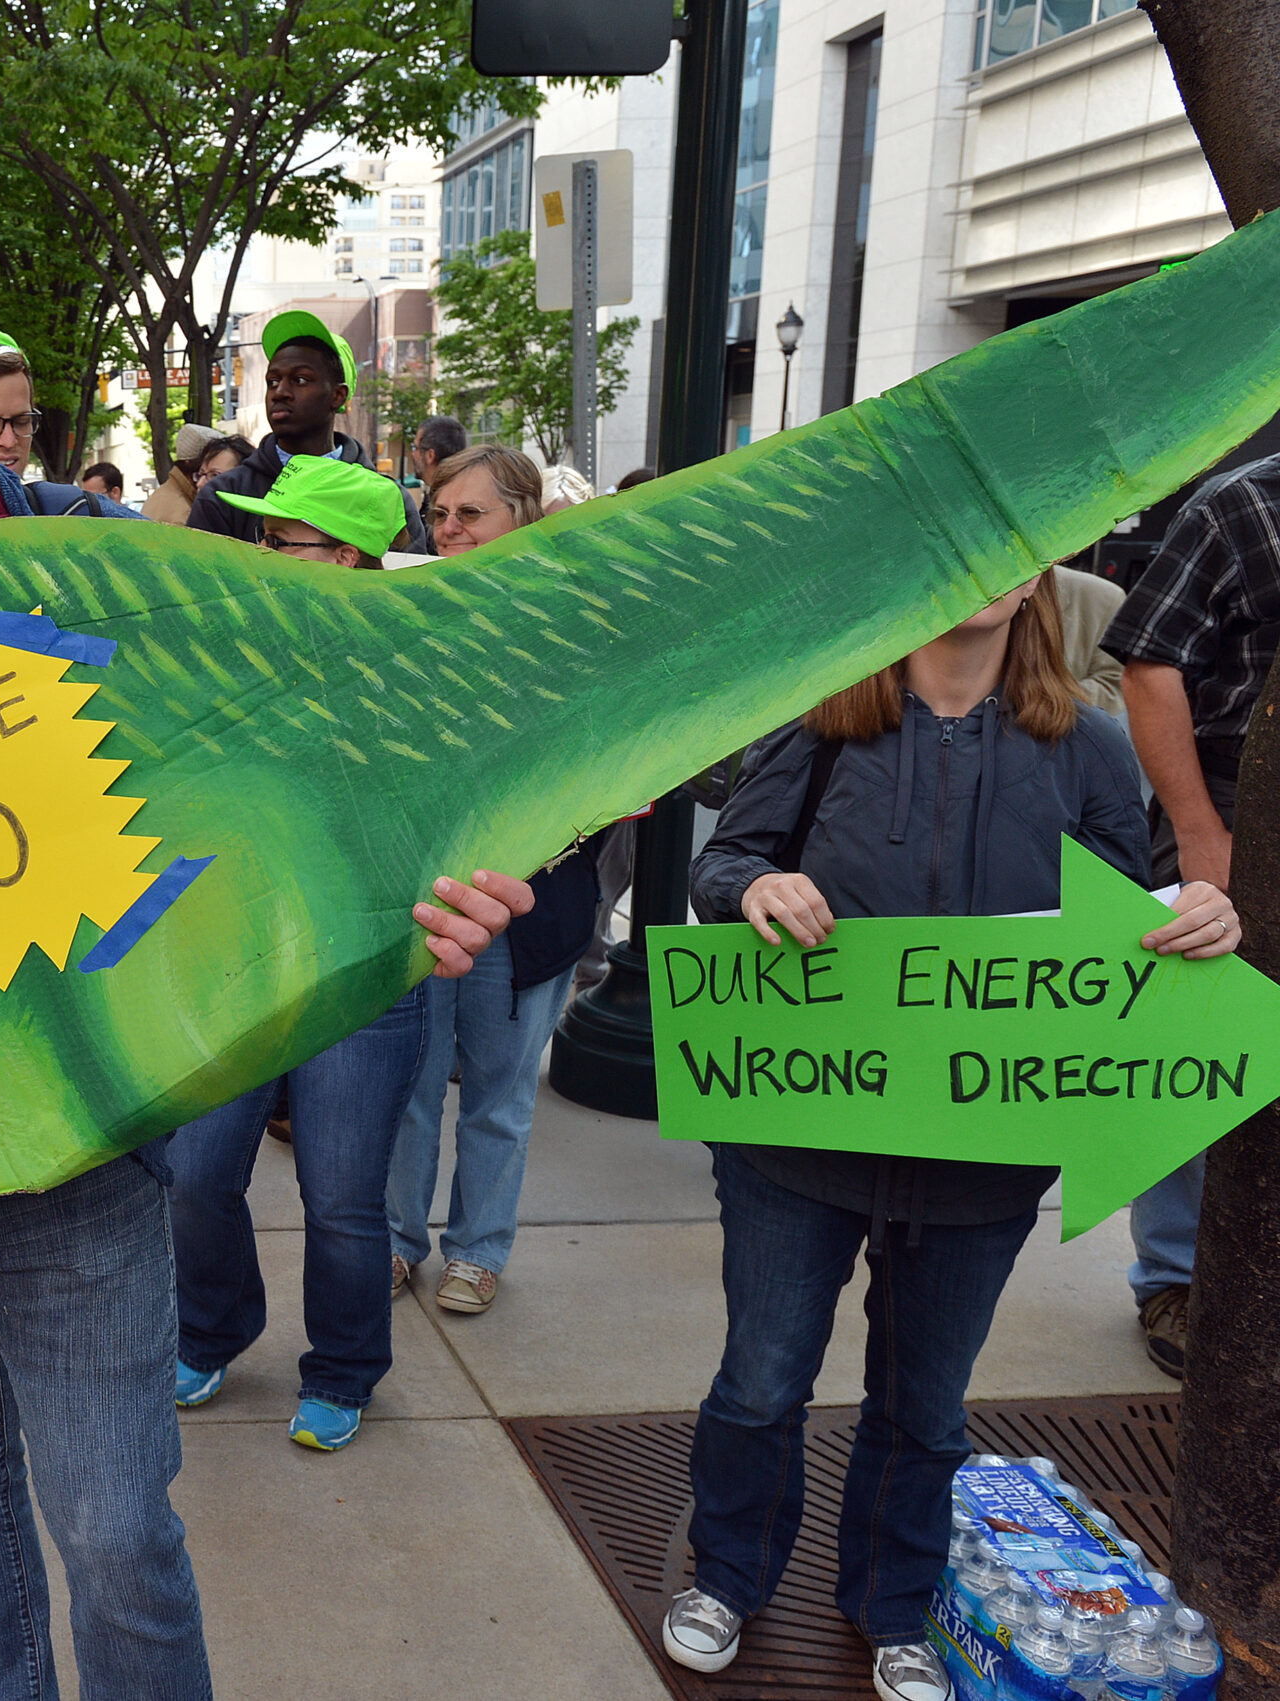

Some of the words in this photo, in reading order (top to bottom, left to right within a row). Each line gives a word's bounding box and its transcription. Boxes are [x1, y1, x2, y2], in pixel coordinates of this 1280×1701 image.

[663, 946, 844, 1009] DUKE
[897, 945, 1158, 1020] ENERGY
[678, 1036, 888, 1099] WRONG
[949, 1050, 1249, 1103] DIRECTION
[979, 1470, 1035, 1514] LINEUP
[952, 1618, 1004, 1687] PARK
